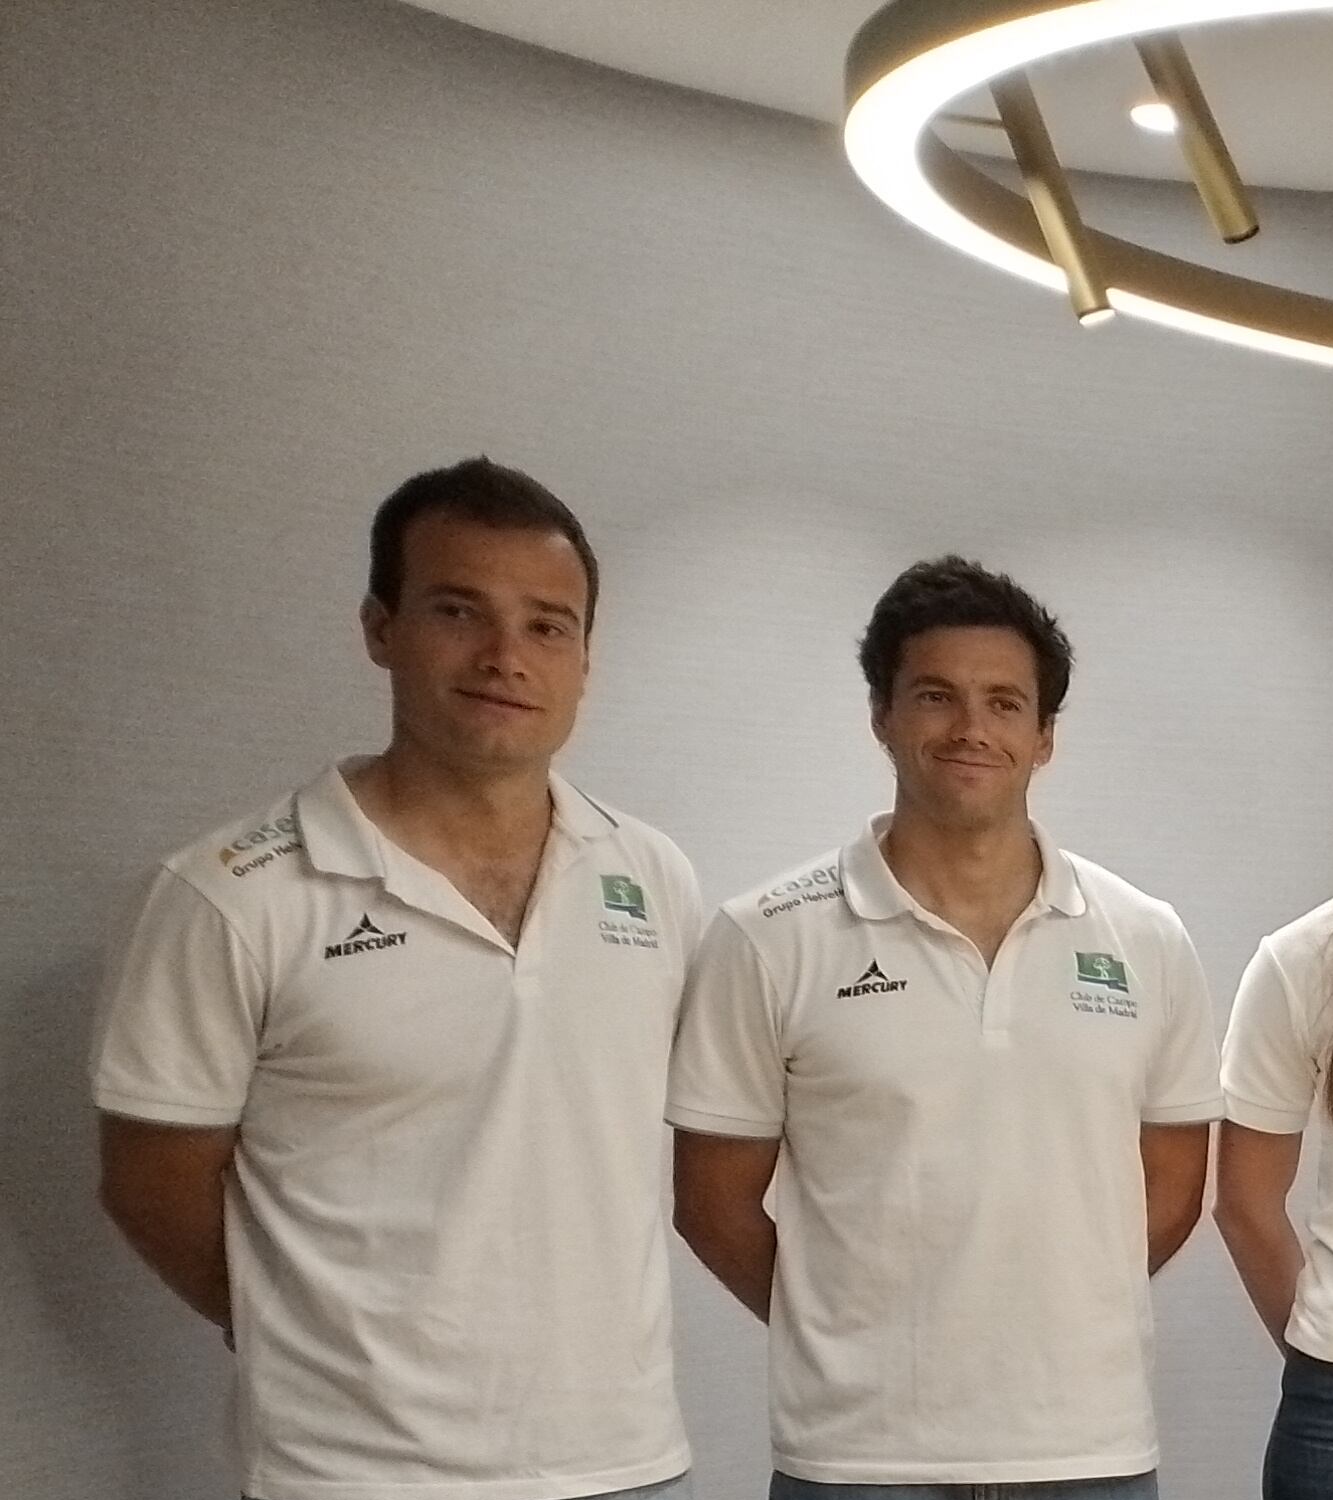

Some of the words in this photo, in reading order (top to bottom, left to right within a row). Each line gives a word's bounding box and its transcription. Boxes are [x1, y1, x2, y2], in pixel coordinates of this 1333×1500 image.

[771, 865, 838, 896] caser
[763, 899, 801, 918] Grupo
[324, 932, 406, 959] MERCURY
[837, 980, 907, 998] MERCURY
